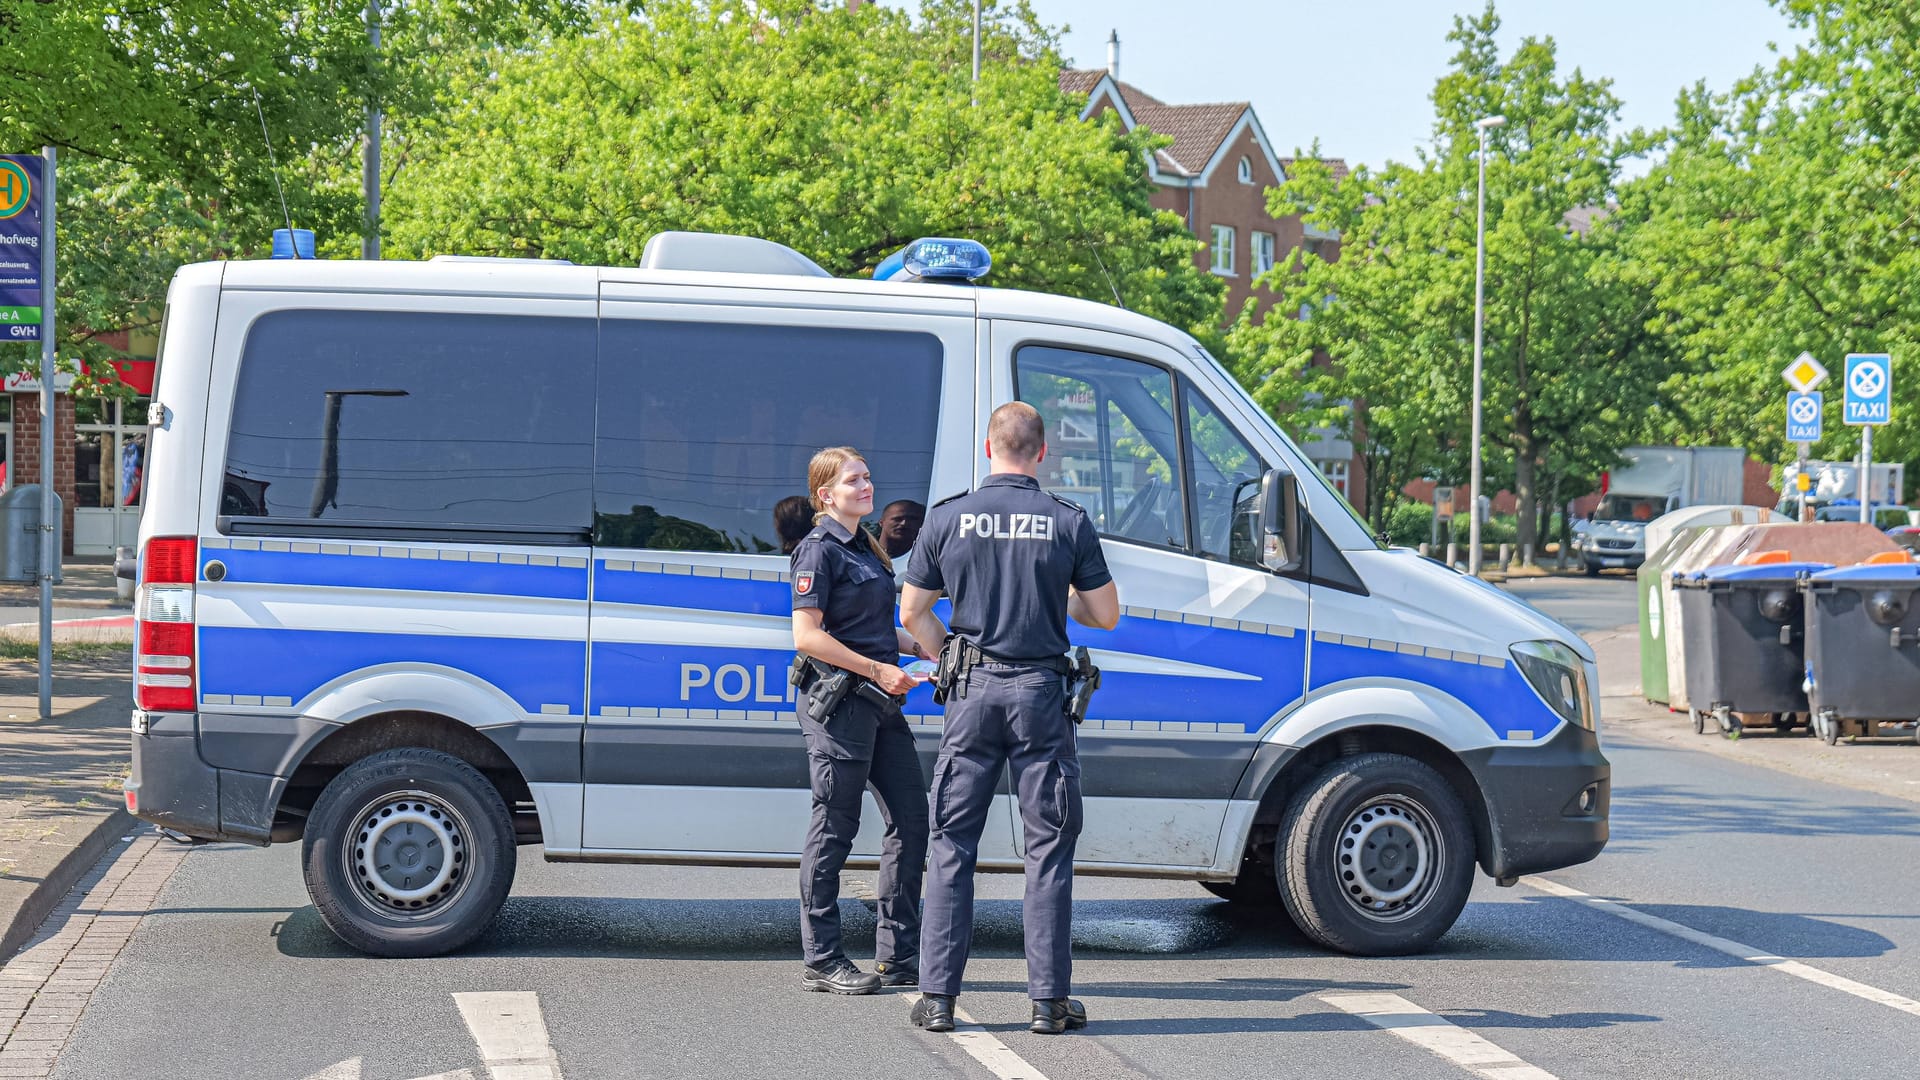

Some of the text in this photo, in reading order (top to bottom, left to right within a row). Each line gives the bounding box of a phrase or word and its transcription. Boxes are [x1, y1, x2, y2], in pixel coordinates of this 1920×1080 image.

[11, 310, 20, 320] A
[10, 326, 36, 336] GVH
[1849, 402, 1885, 417] TAXI
[1791, 425, 1817, 437] TAXI
[960, 513, 1053, 540] POLIZEI
